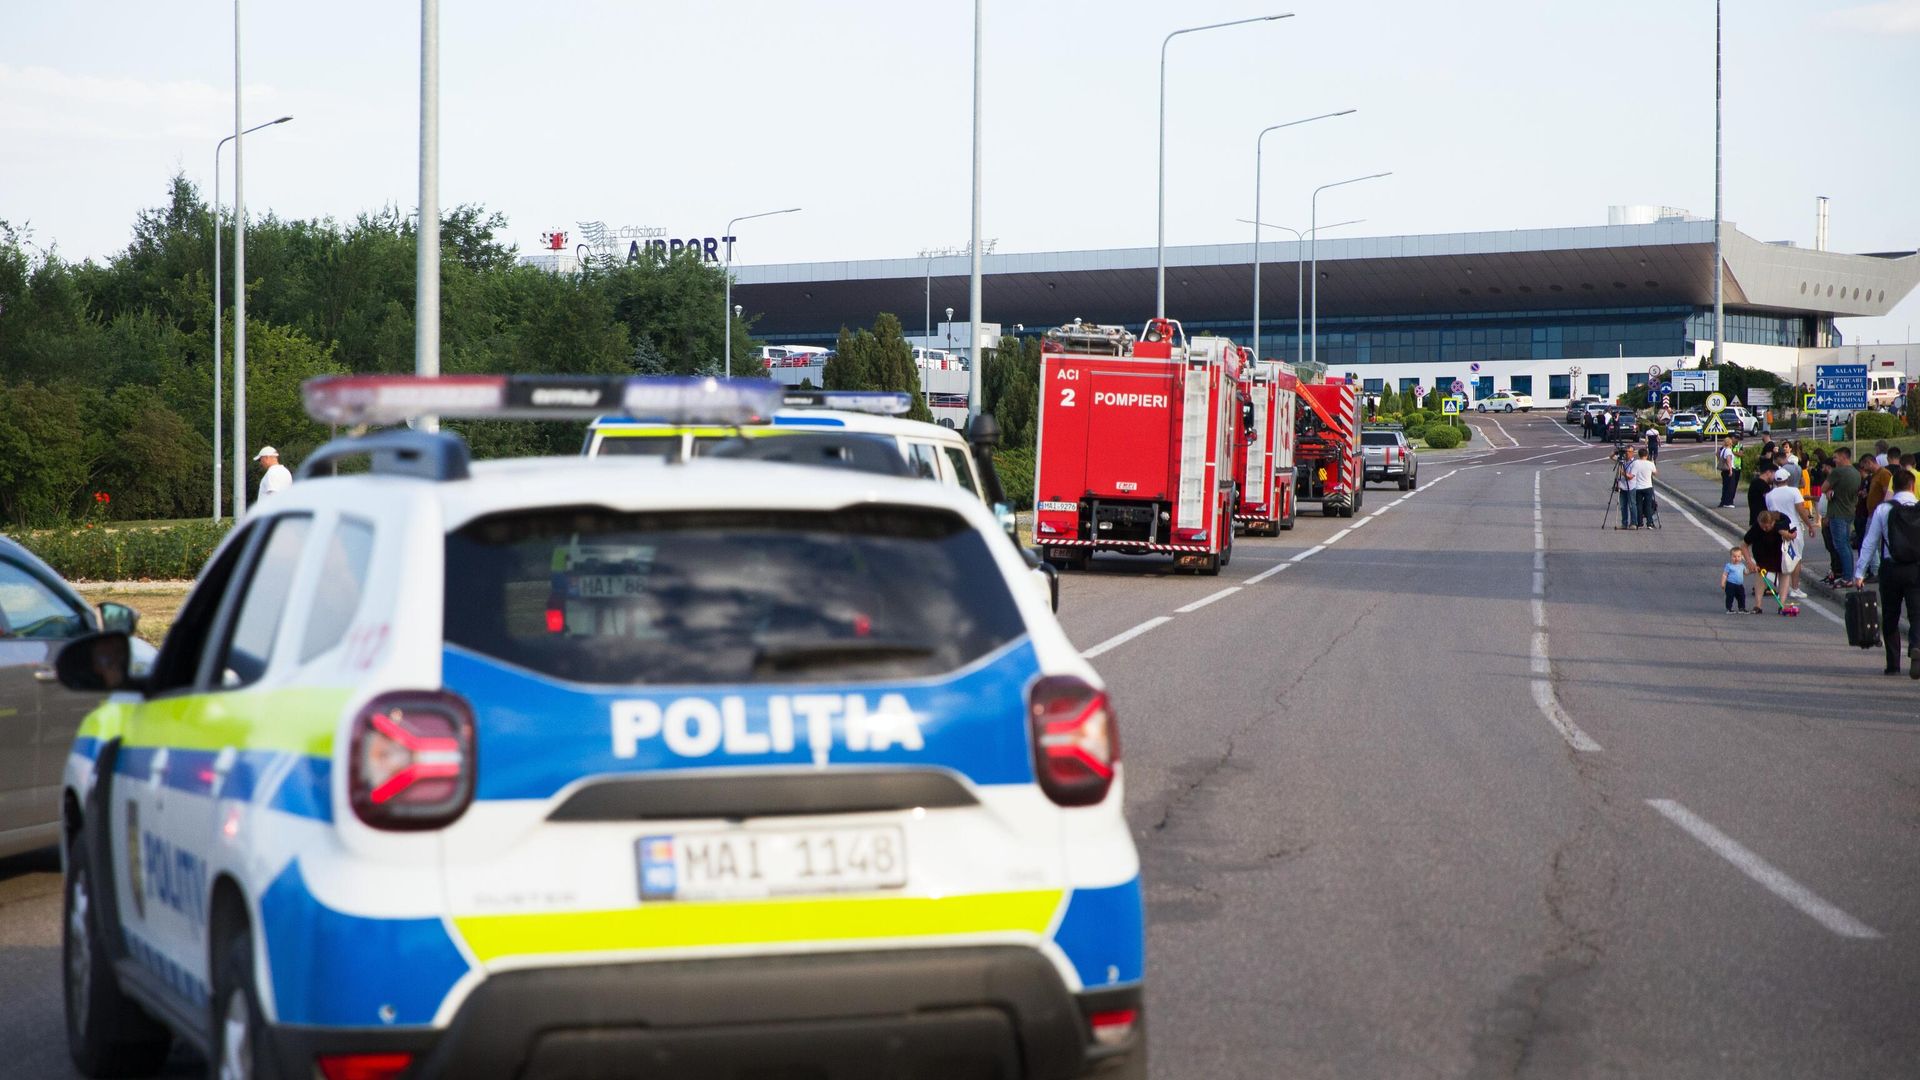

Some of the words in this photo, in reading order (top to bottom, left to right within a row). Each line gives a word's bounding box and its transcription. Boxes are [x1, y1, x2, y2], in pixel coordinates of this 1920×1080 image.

[1057, 369, 1079, 380] ACI
[1060, 388, 1076, 407] 2
[1094, 392, 1168, 408] POMPIERI
[1711, 398, 1721, 407] 30
[685, 838, 763, 882] MAI
[797, 834, 895, 878] 1148
